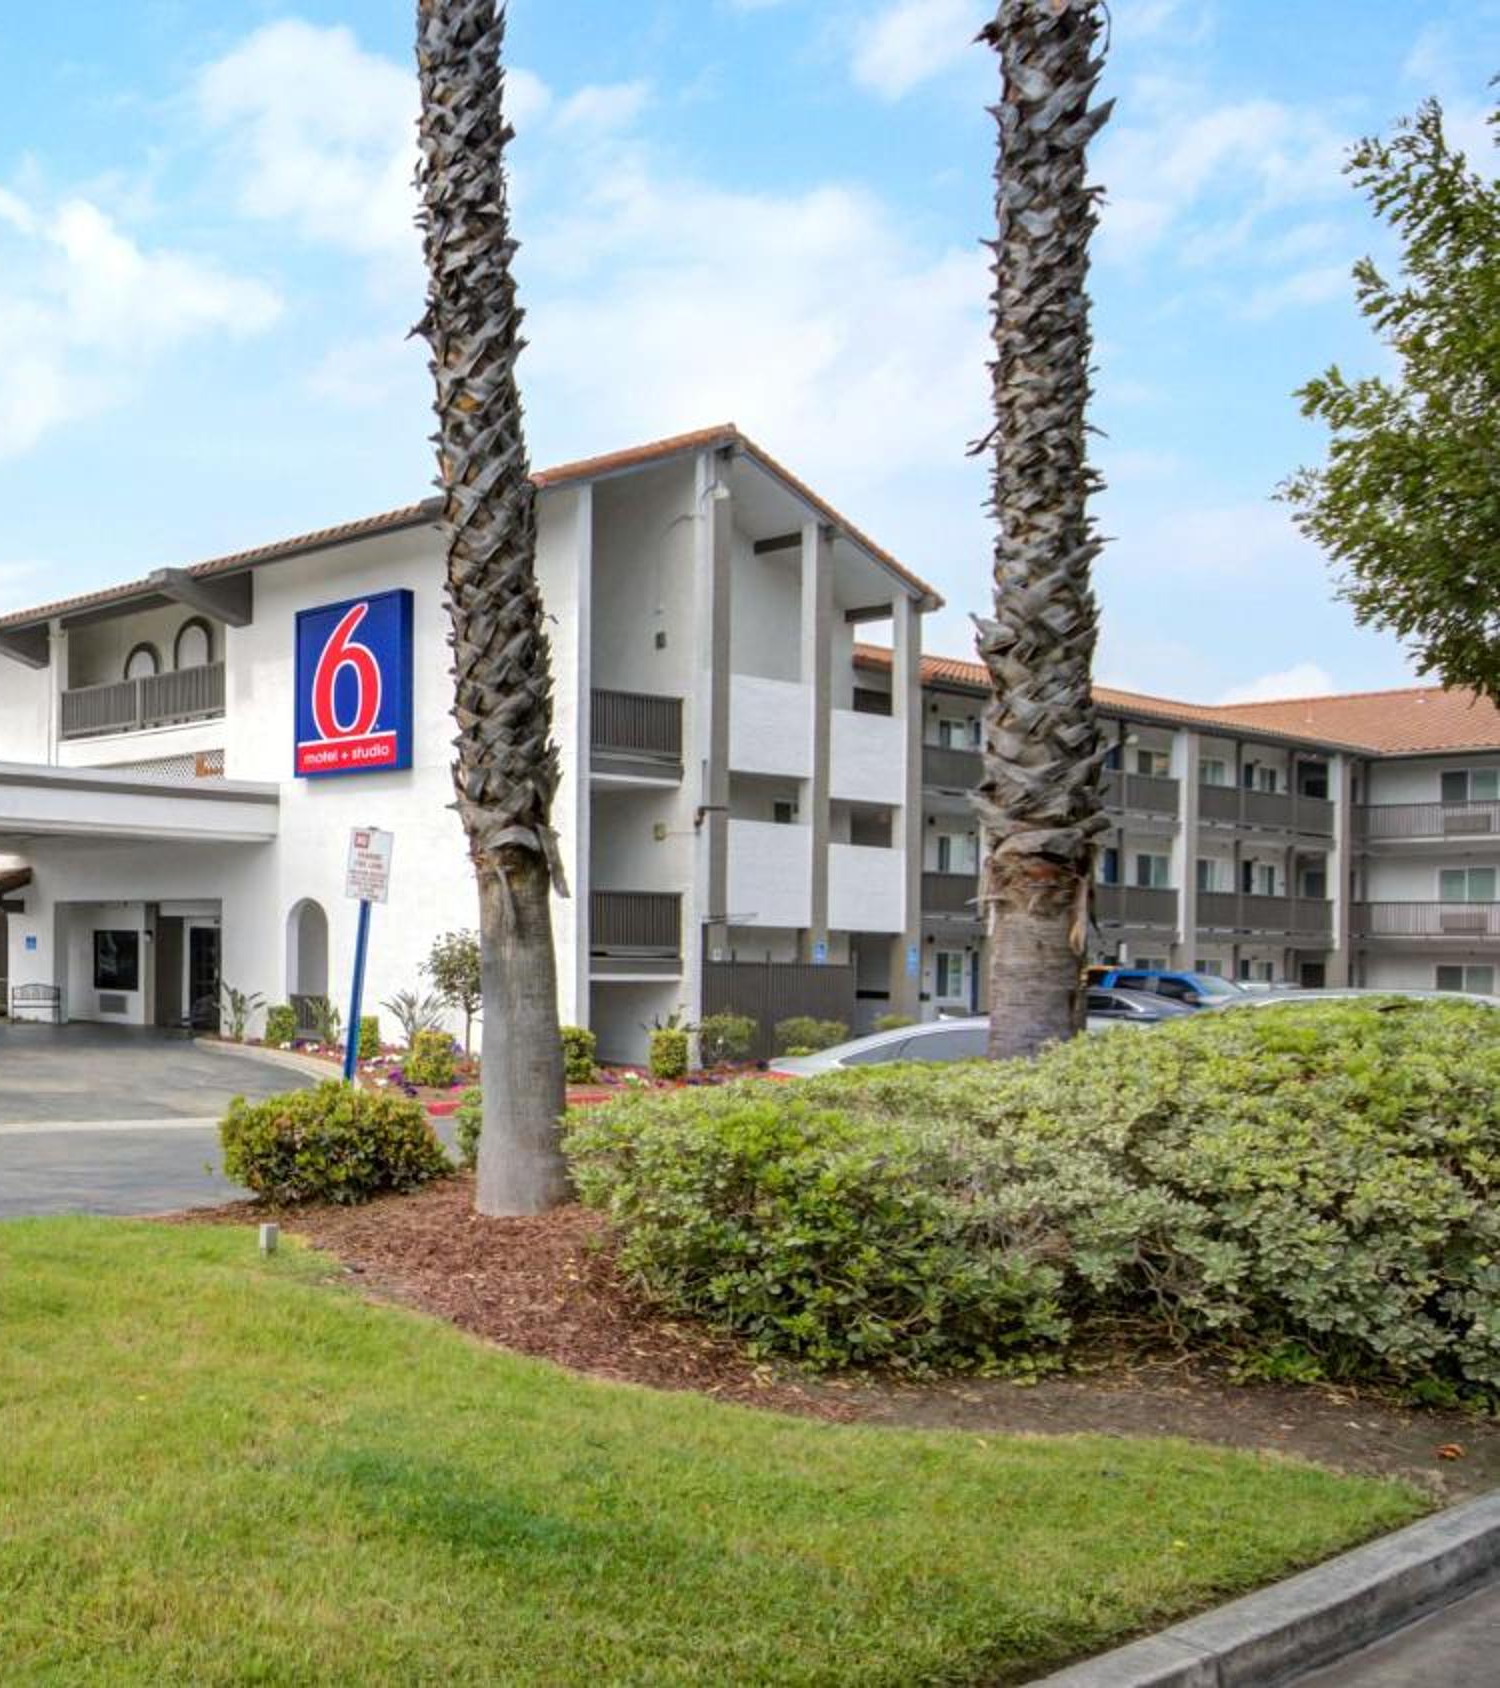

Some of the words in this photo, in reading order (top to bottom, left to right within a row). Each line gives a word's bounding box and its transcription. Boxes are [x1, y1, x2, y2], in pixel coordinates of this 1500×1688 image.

[312, 602, 382, 740] 6
[303, 749, 338, 765] motel
[352, 744, 389, 760] studio
